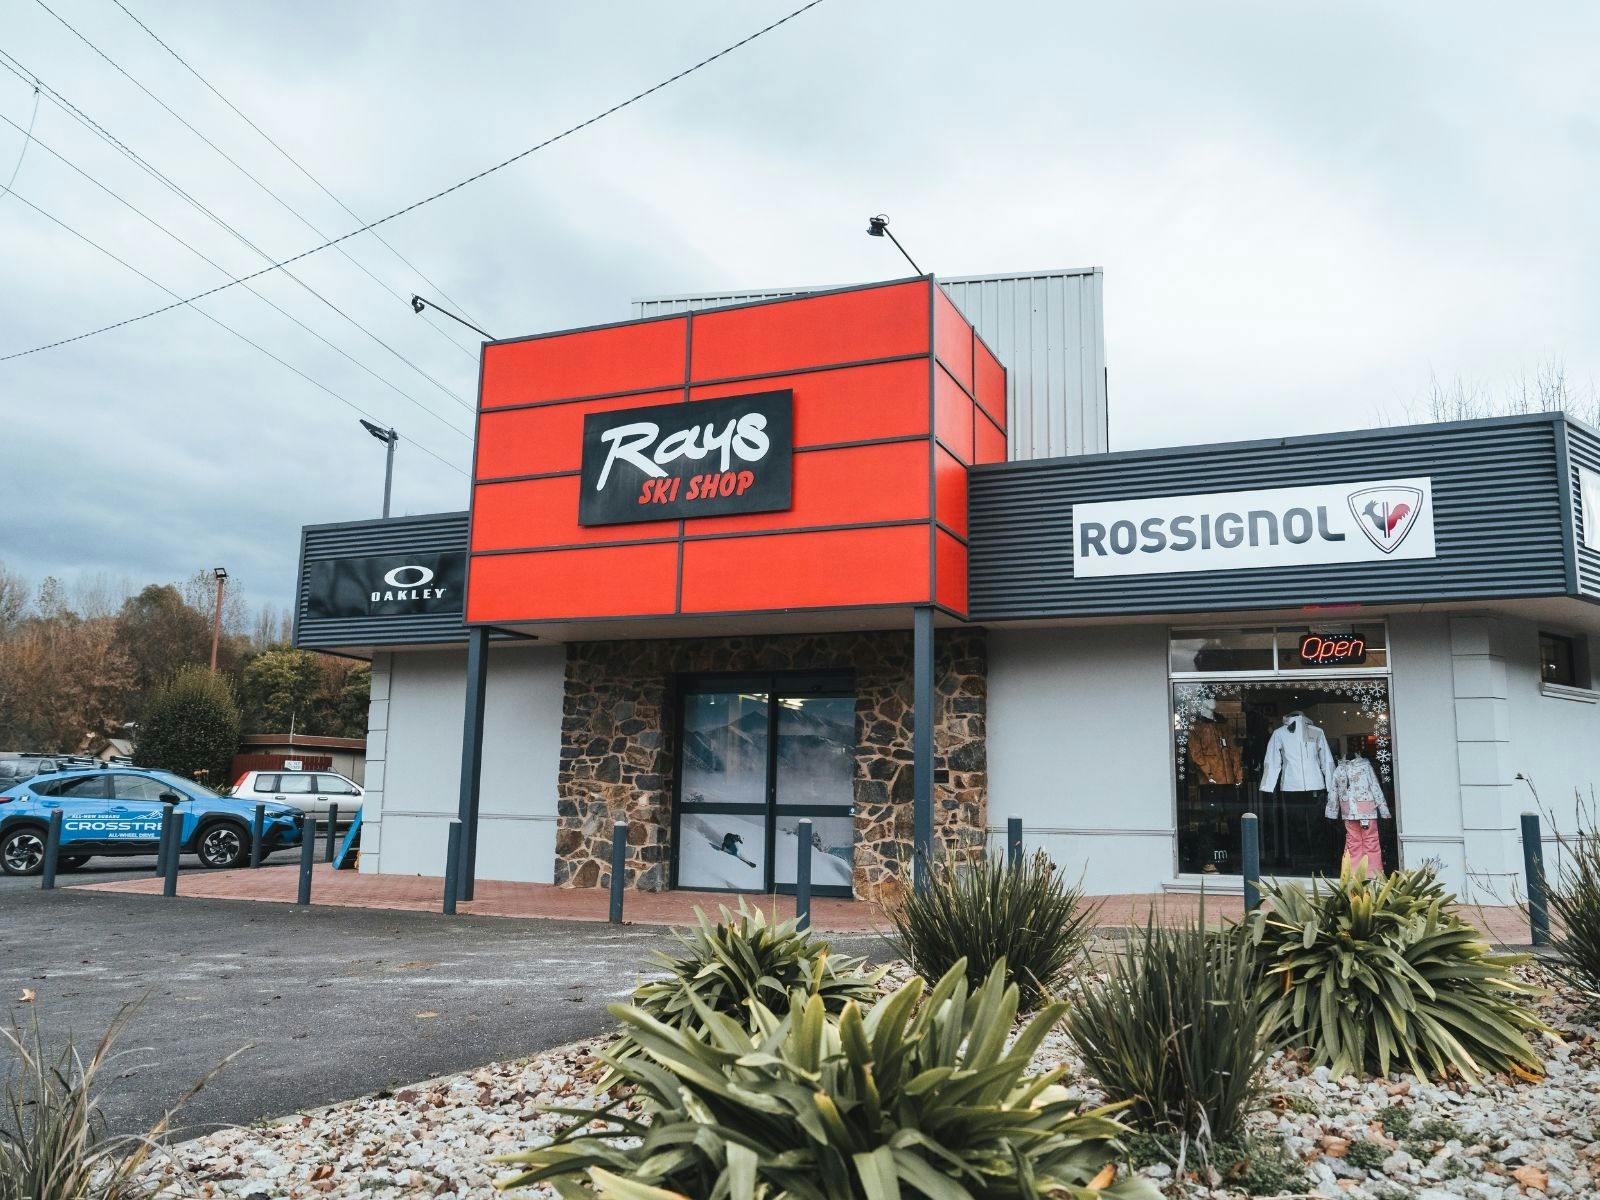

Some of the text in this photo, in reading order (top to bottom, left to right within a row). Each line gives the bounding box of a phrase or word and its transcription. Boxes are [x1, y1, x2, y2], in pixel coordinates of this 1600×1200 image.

[596, 412, 770, 491] Rays
[638, 470, 755, 505] SKI SHOP
[1080, 505, 1346, 558] ROSSIGNOL
[371, 588, 445, 602] OAKLEY
[1301, 637, 1364, 663] Open
[65, 822, 163, 831] CROSSTRE
